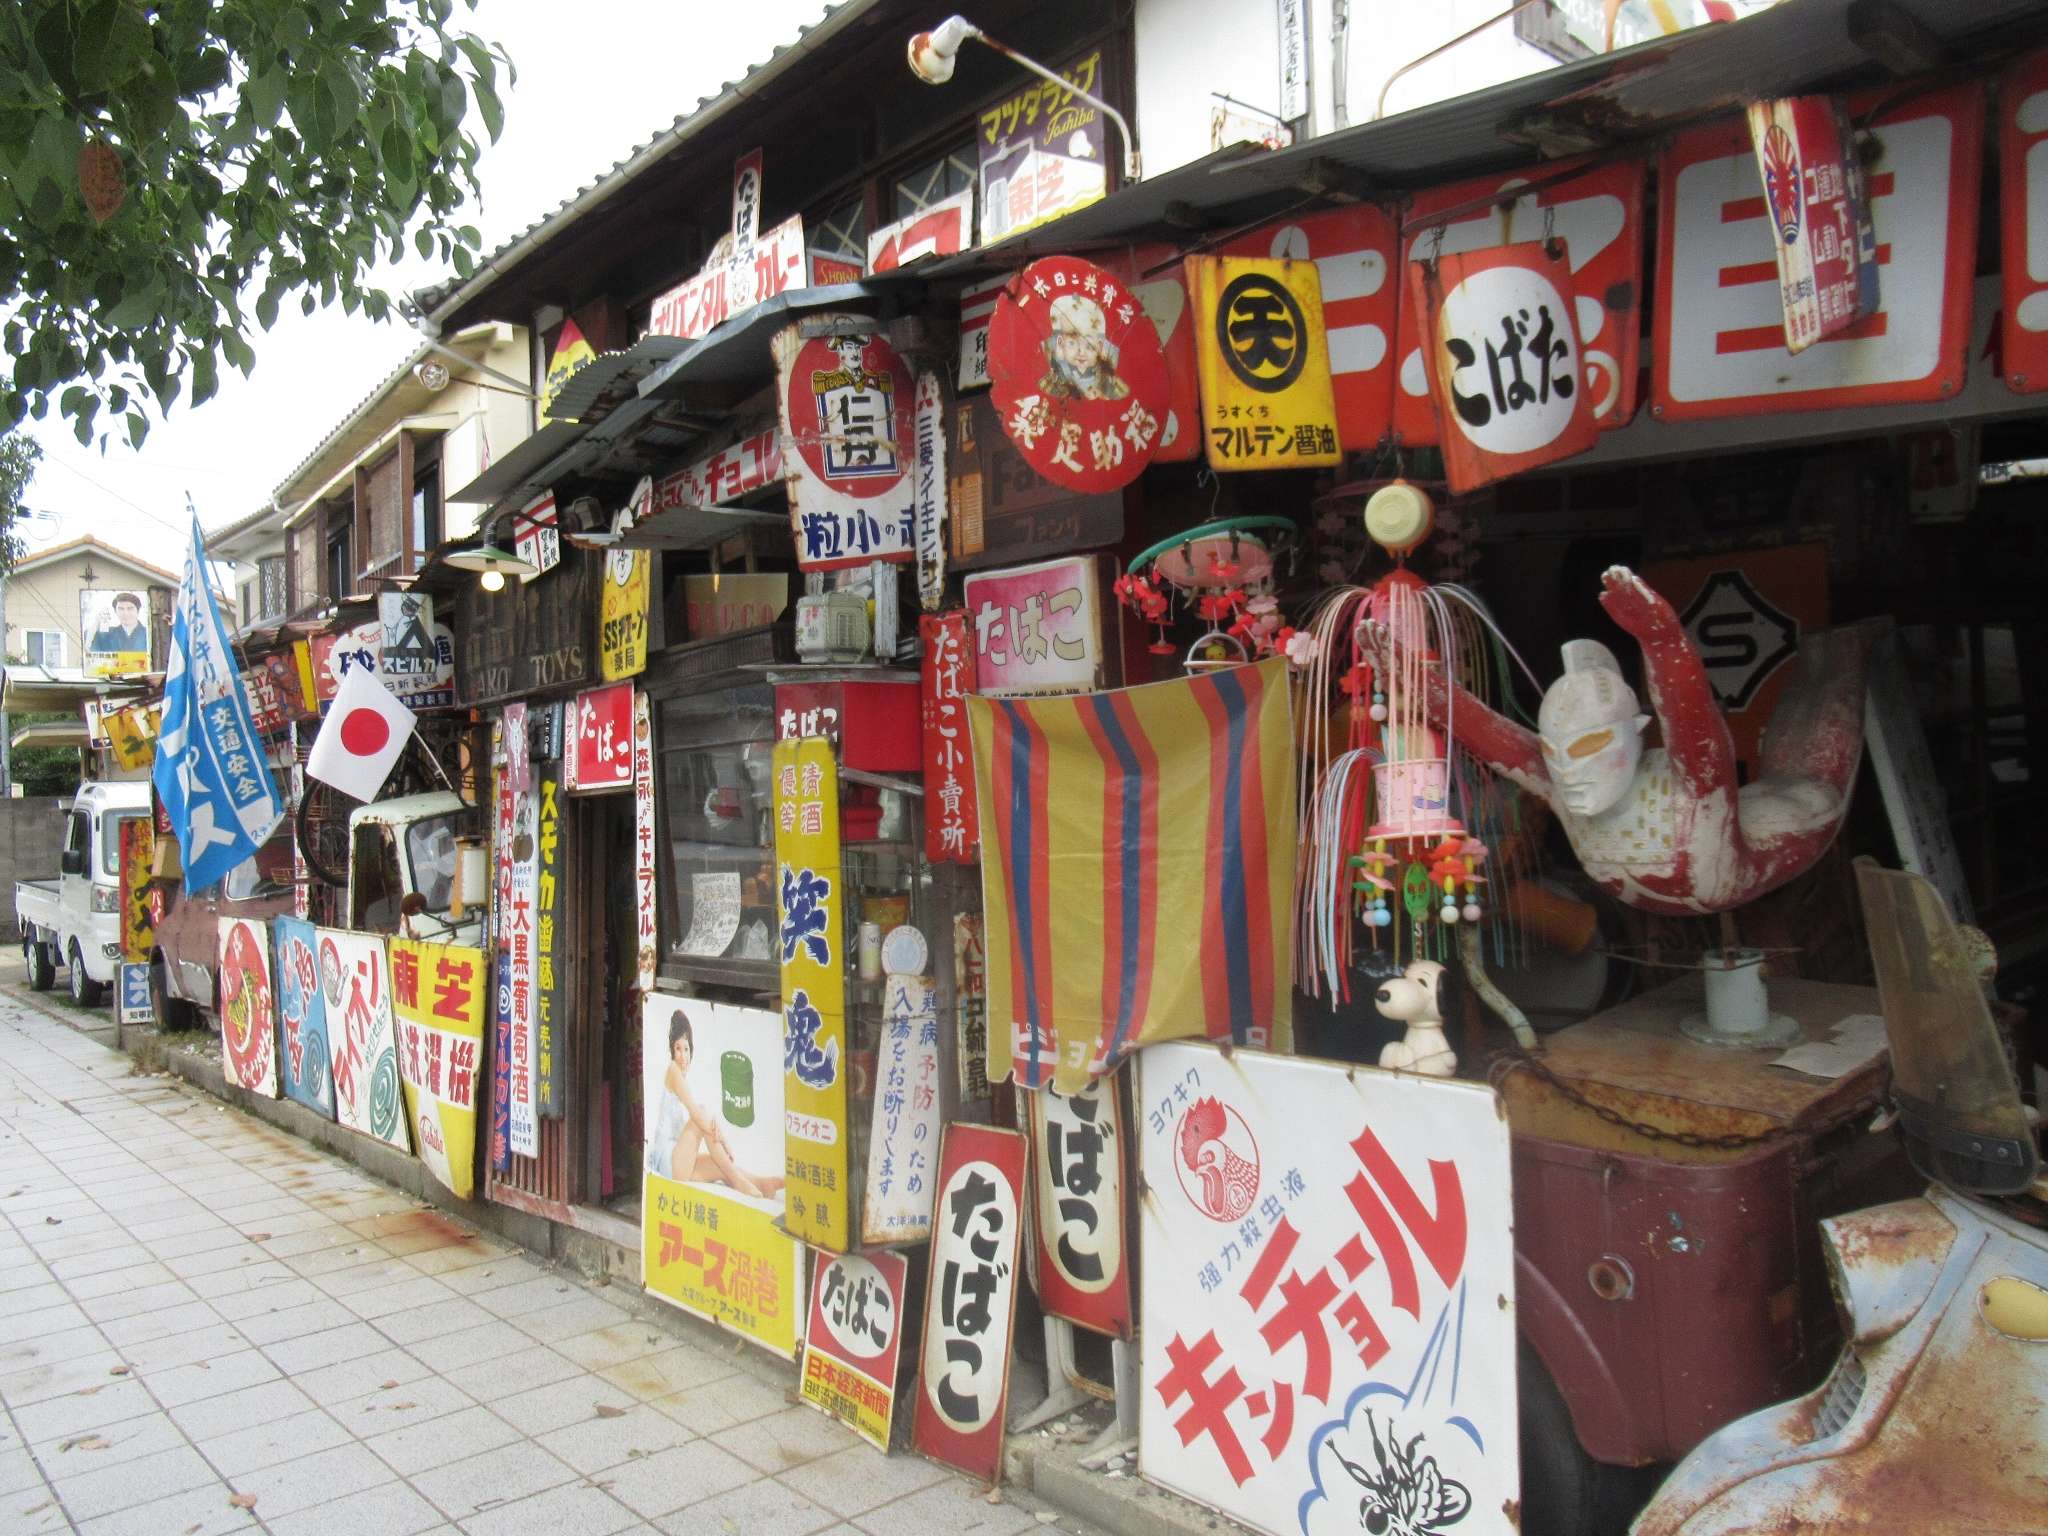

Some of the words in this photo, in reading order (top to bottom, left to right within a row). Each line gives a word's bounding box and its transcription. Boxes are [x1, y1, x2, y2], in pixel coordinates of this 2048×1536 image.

[1043, 106, 1096, 145] Toshiba
[1008, 159, 1066, 225] 東芝
[754, 242, 800, 304] カレー
[1216, 404, 1269, 419] うすくち
[975, 587, 1085, 667] たばこ
[529, 644, 583, 686] TOYS
[211, 708, 260, 800] 交通安全
[580, 698, 629, 778] たばこ
[780, 707, 838, 742] たばこ
[393, 949, 474, 1023] 東芝
[822, 1263, 892, 1350] たばこ
[937, 1170, 1009, 1424] たばこ
